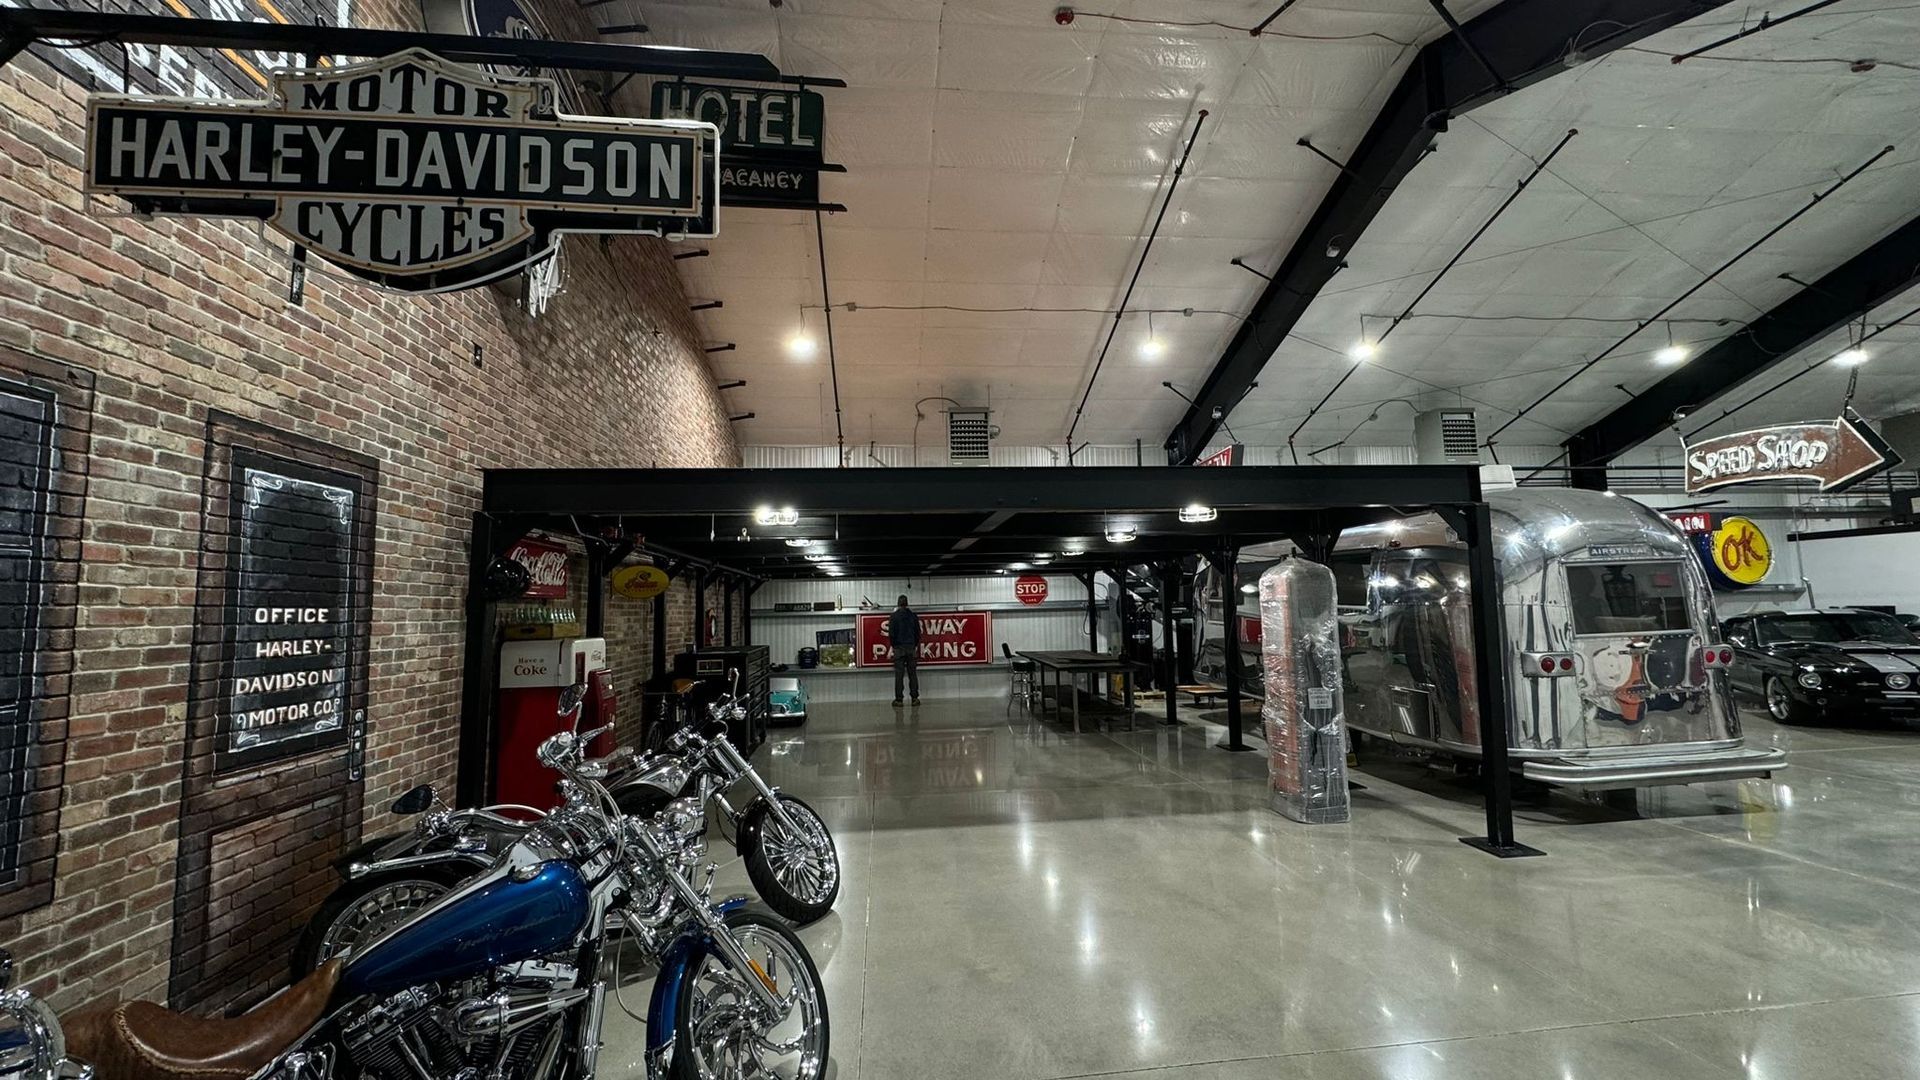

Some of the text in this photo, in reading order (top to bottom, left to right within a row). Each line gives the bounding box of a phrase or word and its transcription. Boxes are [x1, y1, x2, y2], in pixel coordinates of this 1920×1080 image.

[303, 63, 511, 119] MOTOR
[661, 85, 816, 147] HOTEL
[109, 116, 681, 200] HARLEY-DAVIDSON
[297, 201, 506, 266] CYCLES
[1689, 434, 1829, 484] SPEED SHOP
[1721, 525, 1764, 572] OK
[1016, 584, 1046, 594] STOP
[255, 608, 329, 624] OFFICE
[255, 639, 331, 658] HARLEY-
[235, 669, 333, 695] DAVIDSON
[513, 664, 547, 676] Coke
[249, 703, 309, 728] MOTOR
